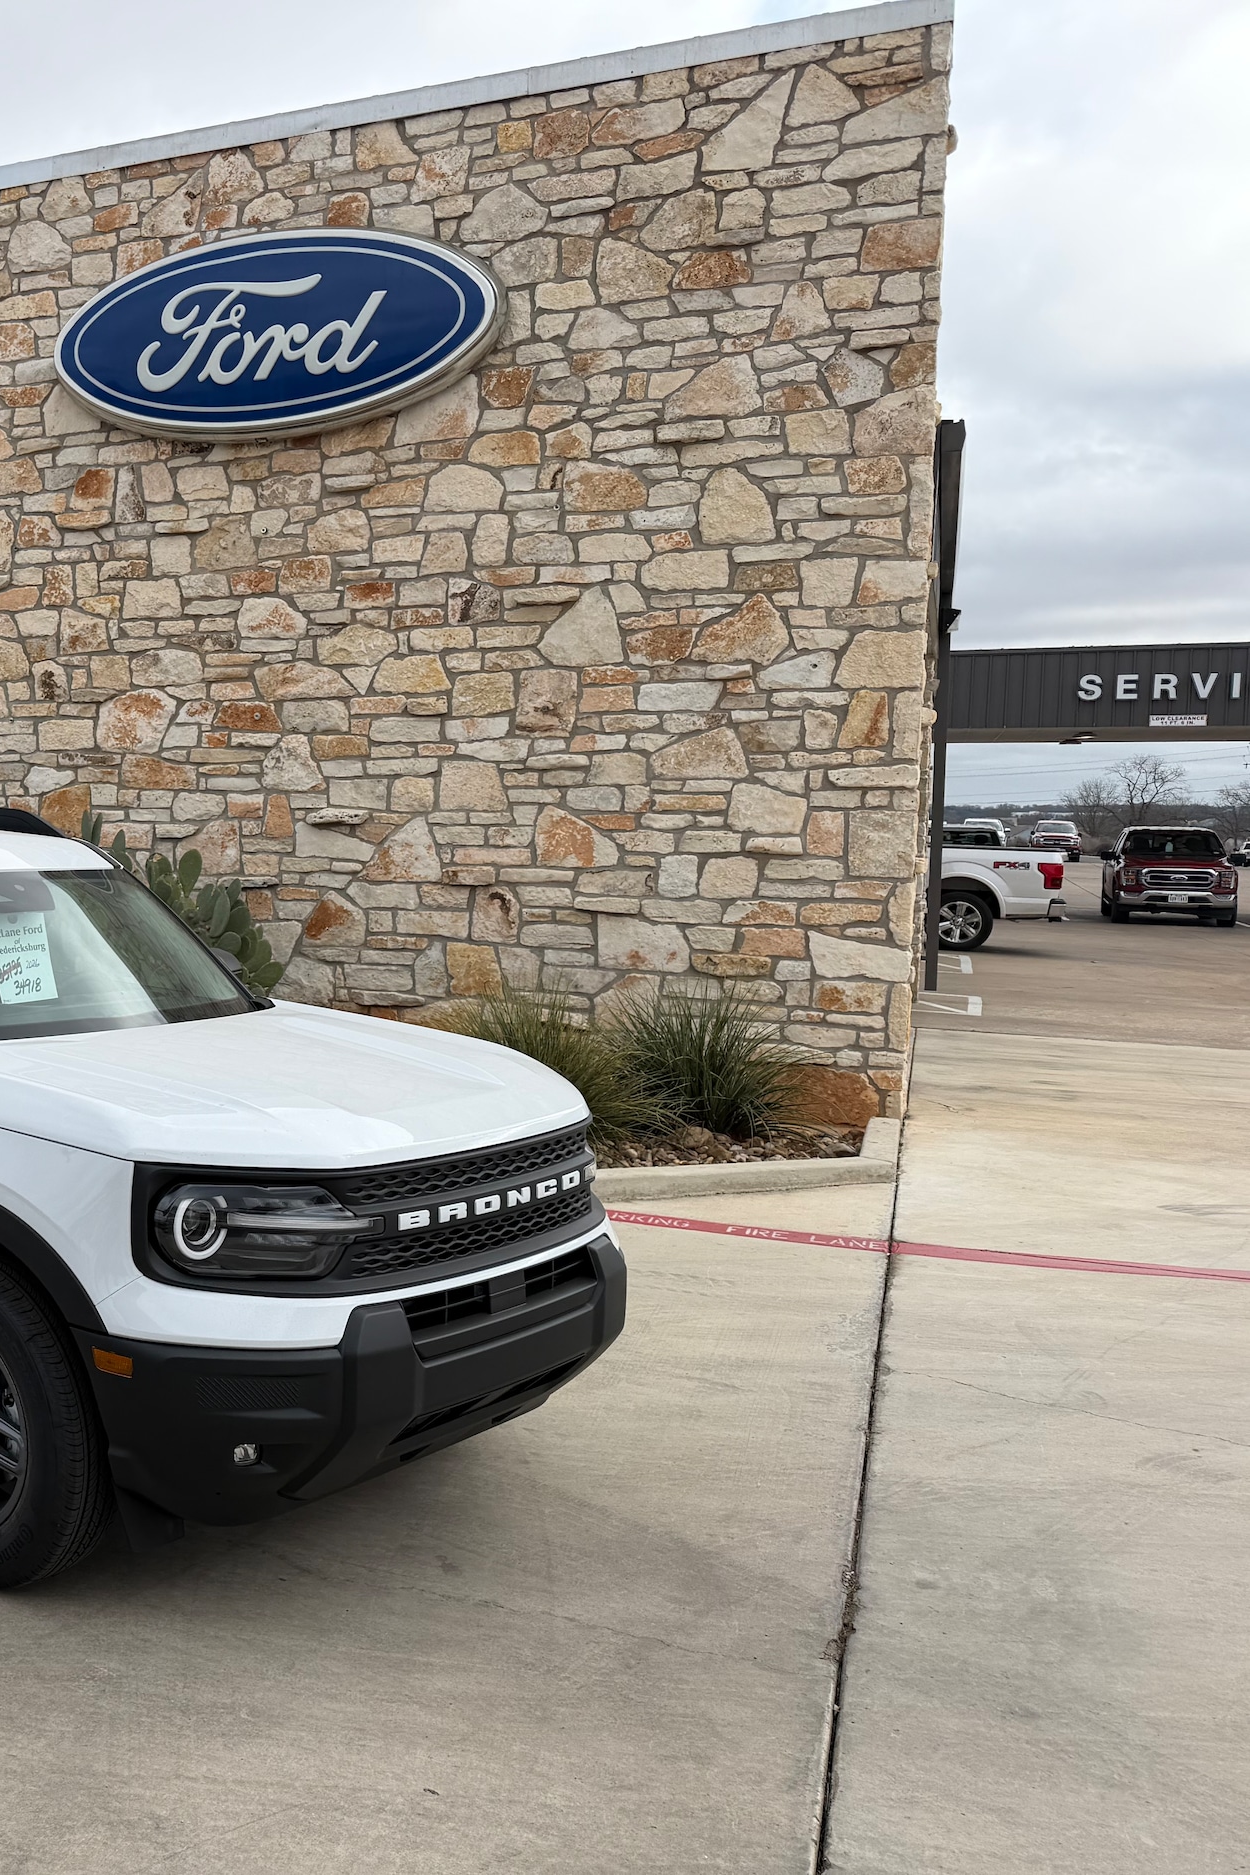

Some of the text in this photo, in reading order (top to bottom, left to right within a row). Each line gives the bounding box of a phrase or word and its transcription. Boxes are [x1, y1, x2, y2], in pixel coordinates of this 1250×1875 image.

[136, 273, 388, 393] Ford
[1077, 672, 1243, 701] SERVI
[993, 861, 1030, 870] FX4
[23, 924, 43, 935] Ford
[14, 977, 42, 996] 34918
[397, 1169, 581, 1232] BRONCO
[726, 1226, 790, 1240] FIRE
[810, 1235, 888, 1251] LANE
